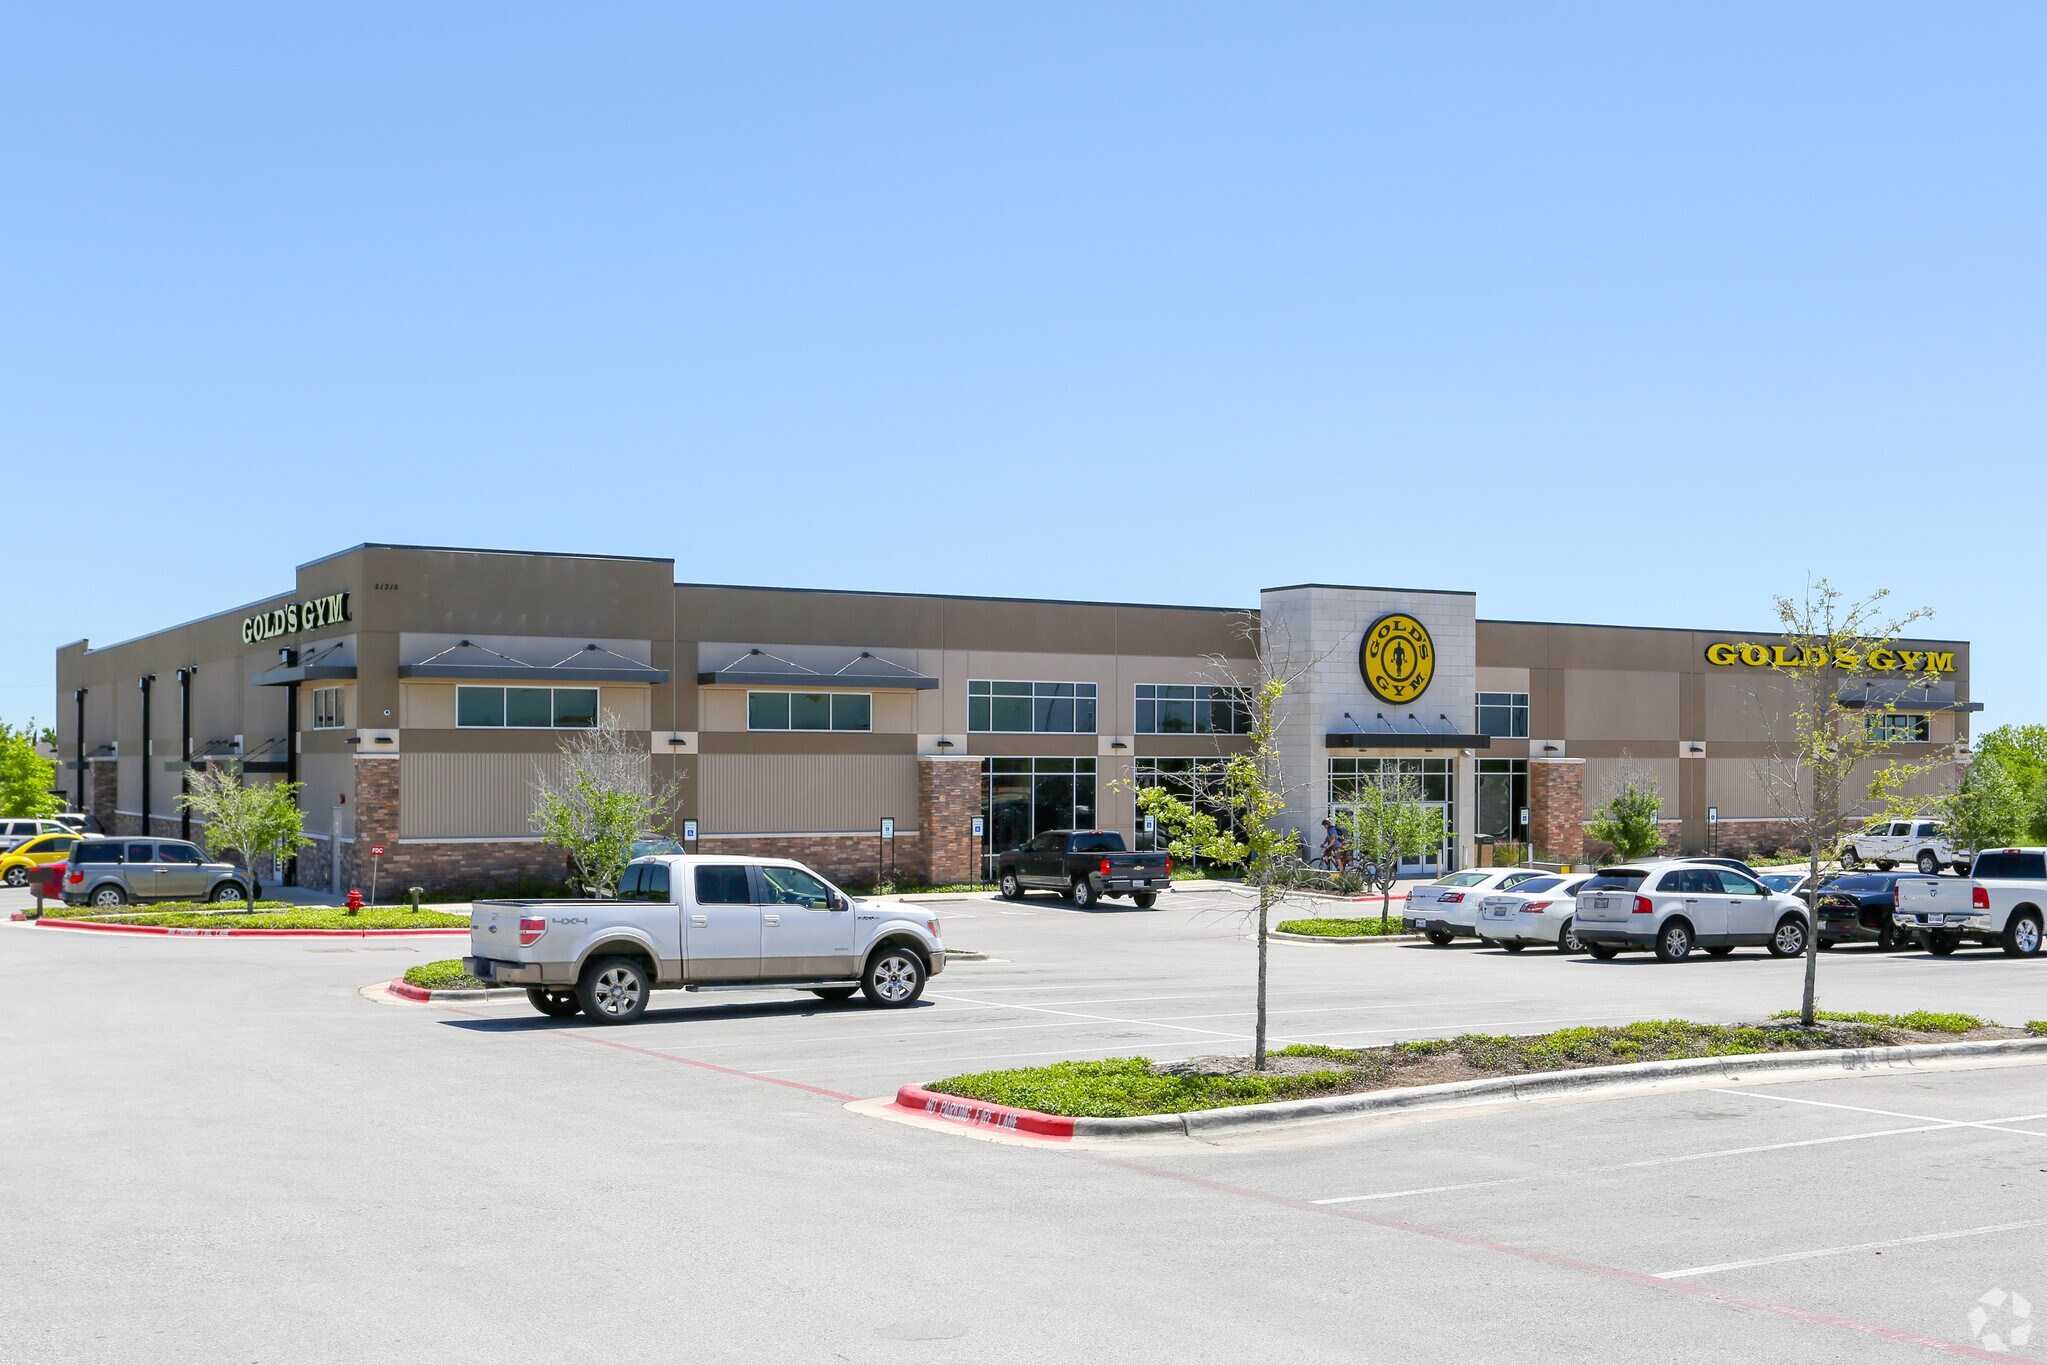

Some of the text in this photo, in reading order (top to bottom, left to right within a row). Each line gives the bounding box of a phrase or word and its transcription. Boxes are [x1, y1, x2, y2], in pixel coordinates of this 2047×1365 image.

[374, 582, 399, 591] 21315
[242, 592, 348, 644] GOLD'S GYM
[1370, 620, 1429, 660] GOLD'S
[1706, 643, 1958, 673] GOLD'S GYM
[1376, 672, 1426, 697] GYM
[926, 1097, 1021, 1131] NO PARKING FIRE LANE
